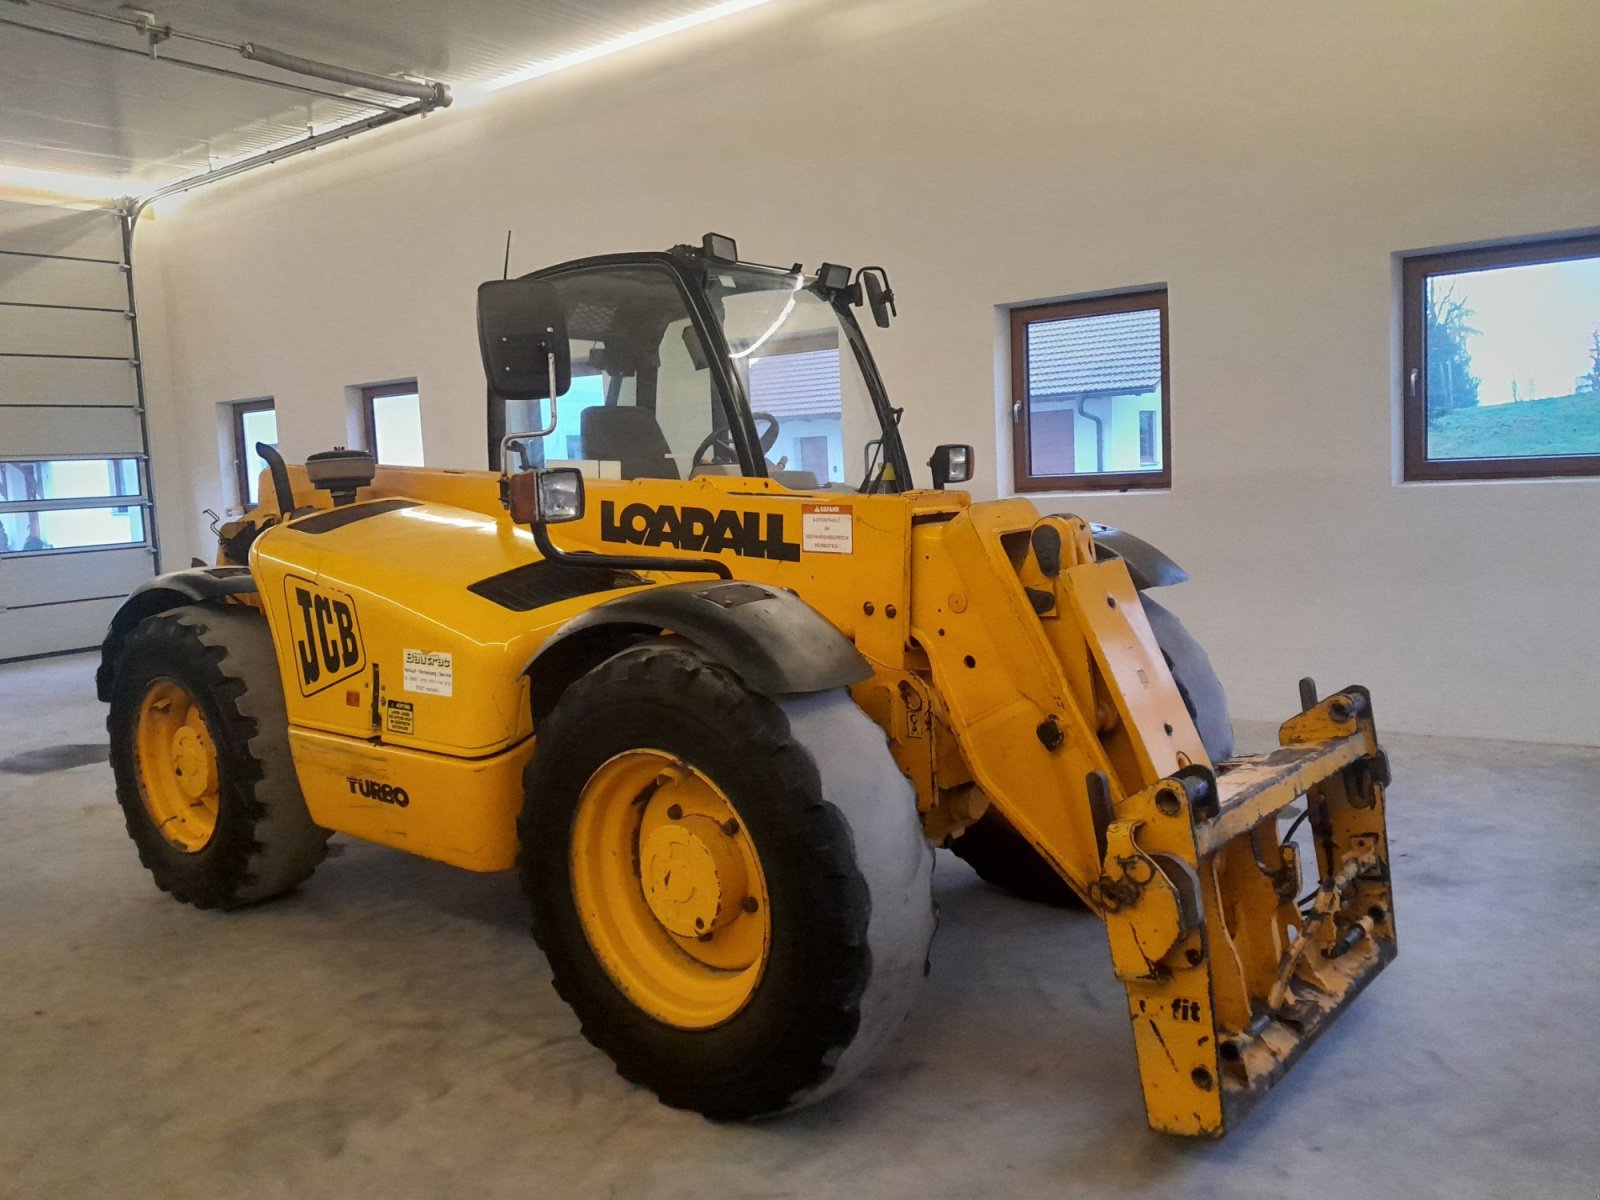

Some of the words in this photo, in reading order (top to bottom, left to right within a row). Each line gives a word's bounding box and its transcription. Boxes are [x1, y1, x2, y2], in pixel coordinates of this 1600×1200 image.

[820, 505, 840, 513] GEFAHR
[601, 500, 801, 562] LOADALL
[295, 587, 359, 686] JCB
[406, 652, 451, 668] Bautrac
[346, 776, 410, 808] TURBO
[1171, 998, 1201, 1022] fit
